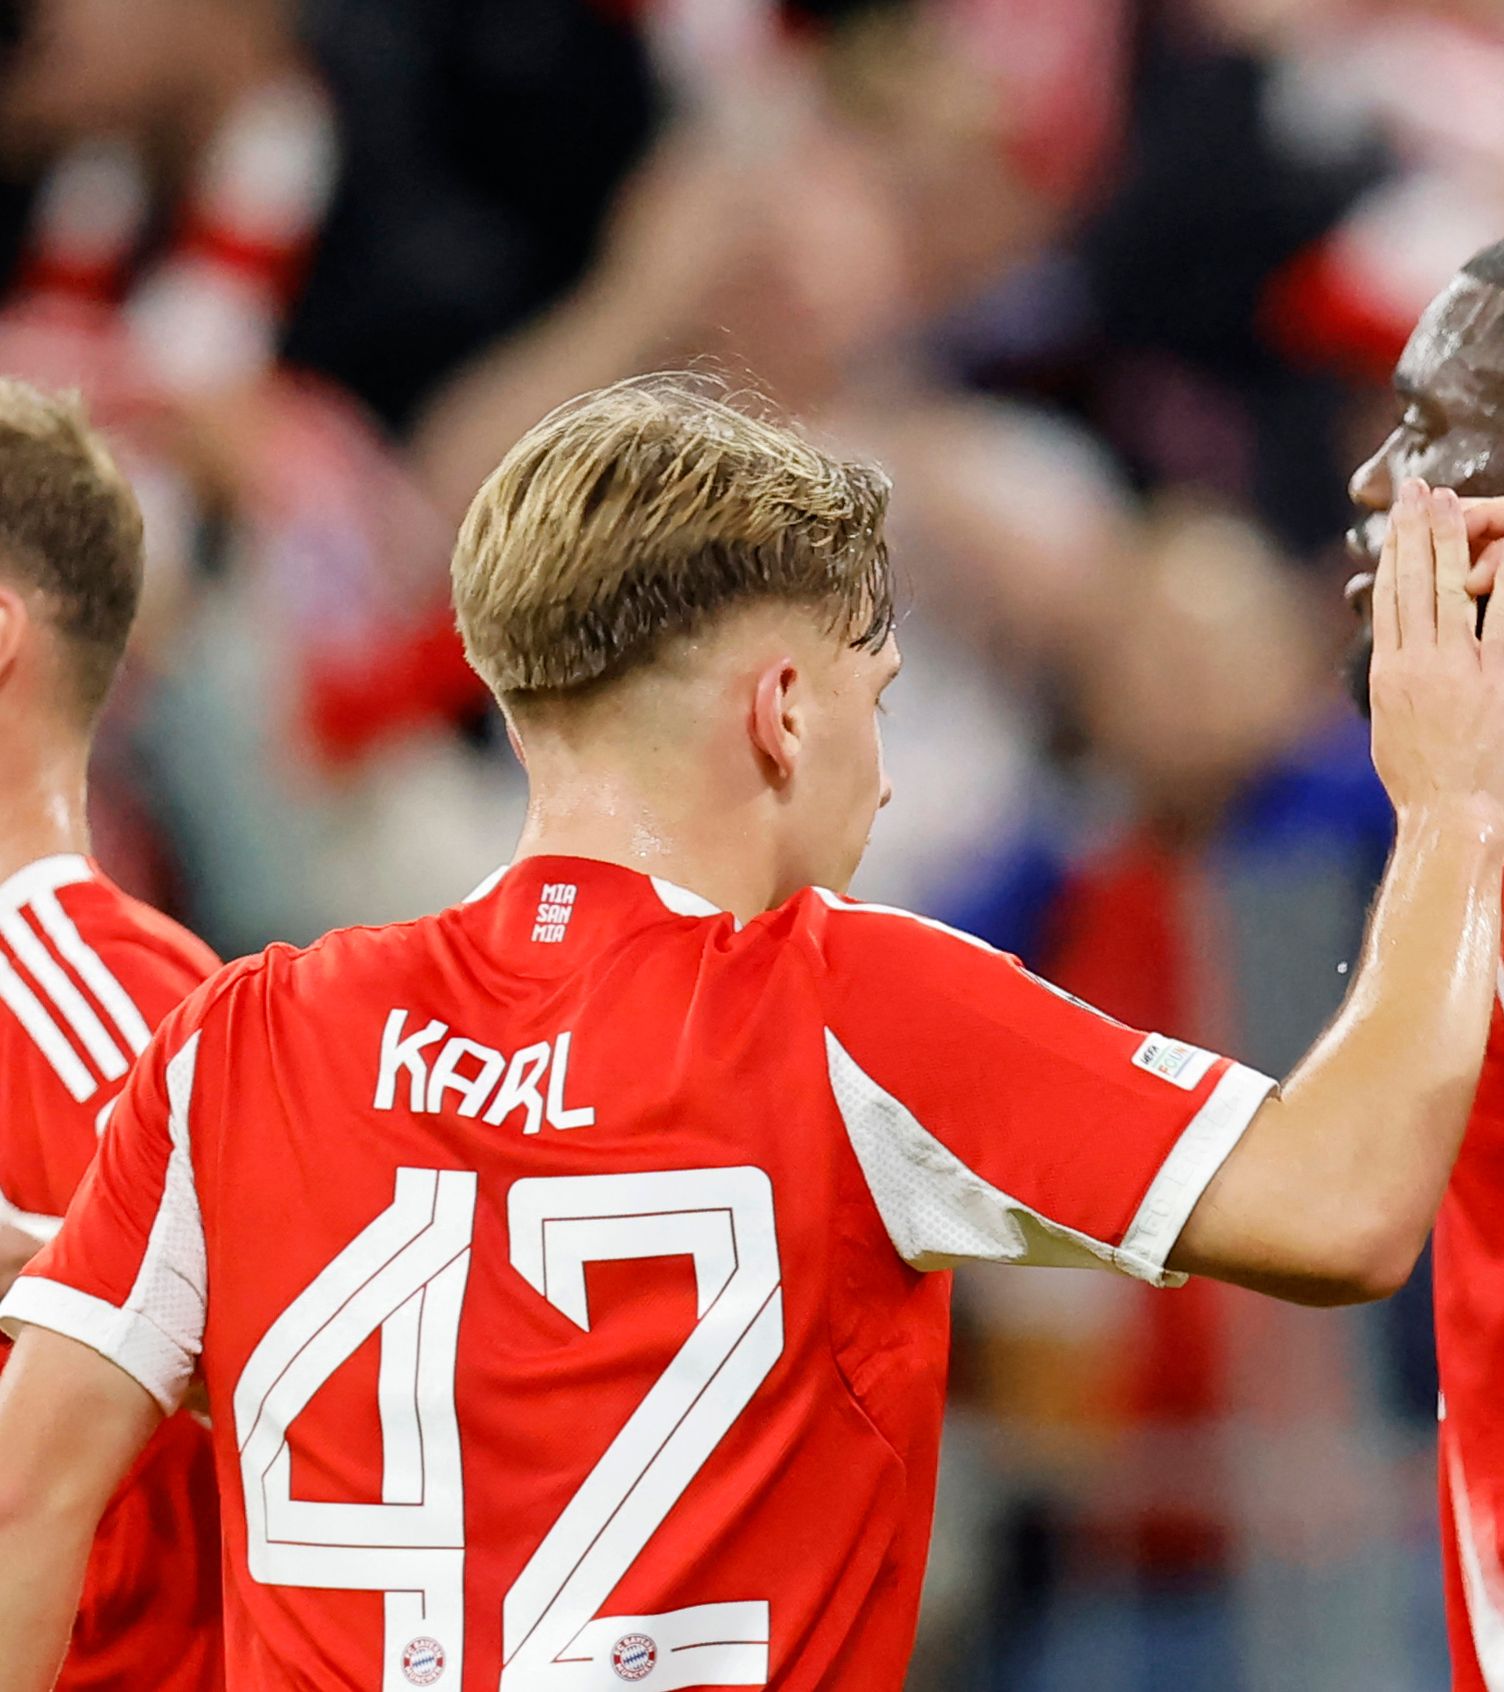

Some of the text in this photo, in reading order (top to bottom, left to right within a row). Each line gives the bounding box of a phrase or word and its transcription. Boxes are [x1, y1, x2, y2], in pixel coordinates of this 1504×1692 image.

[540, 882, 578, 905] MIA
[536, 903, 573, 924] SAN
[530, 923, 567, 943] MIA
[373, 1008, 595, 1135] KARL
[232, 1165, 785, 1692] 42
